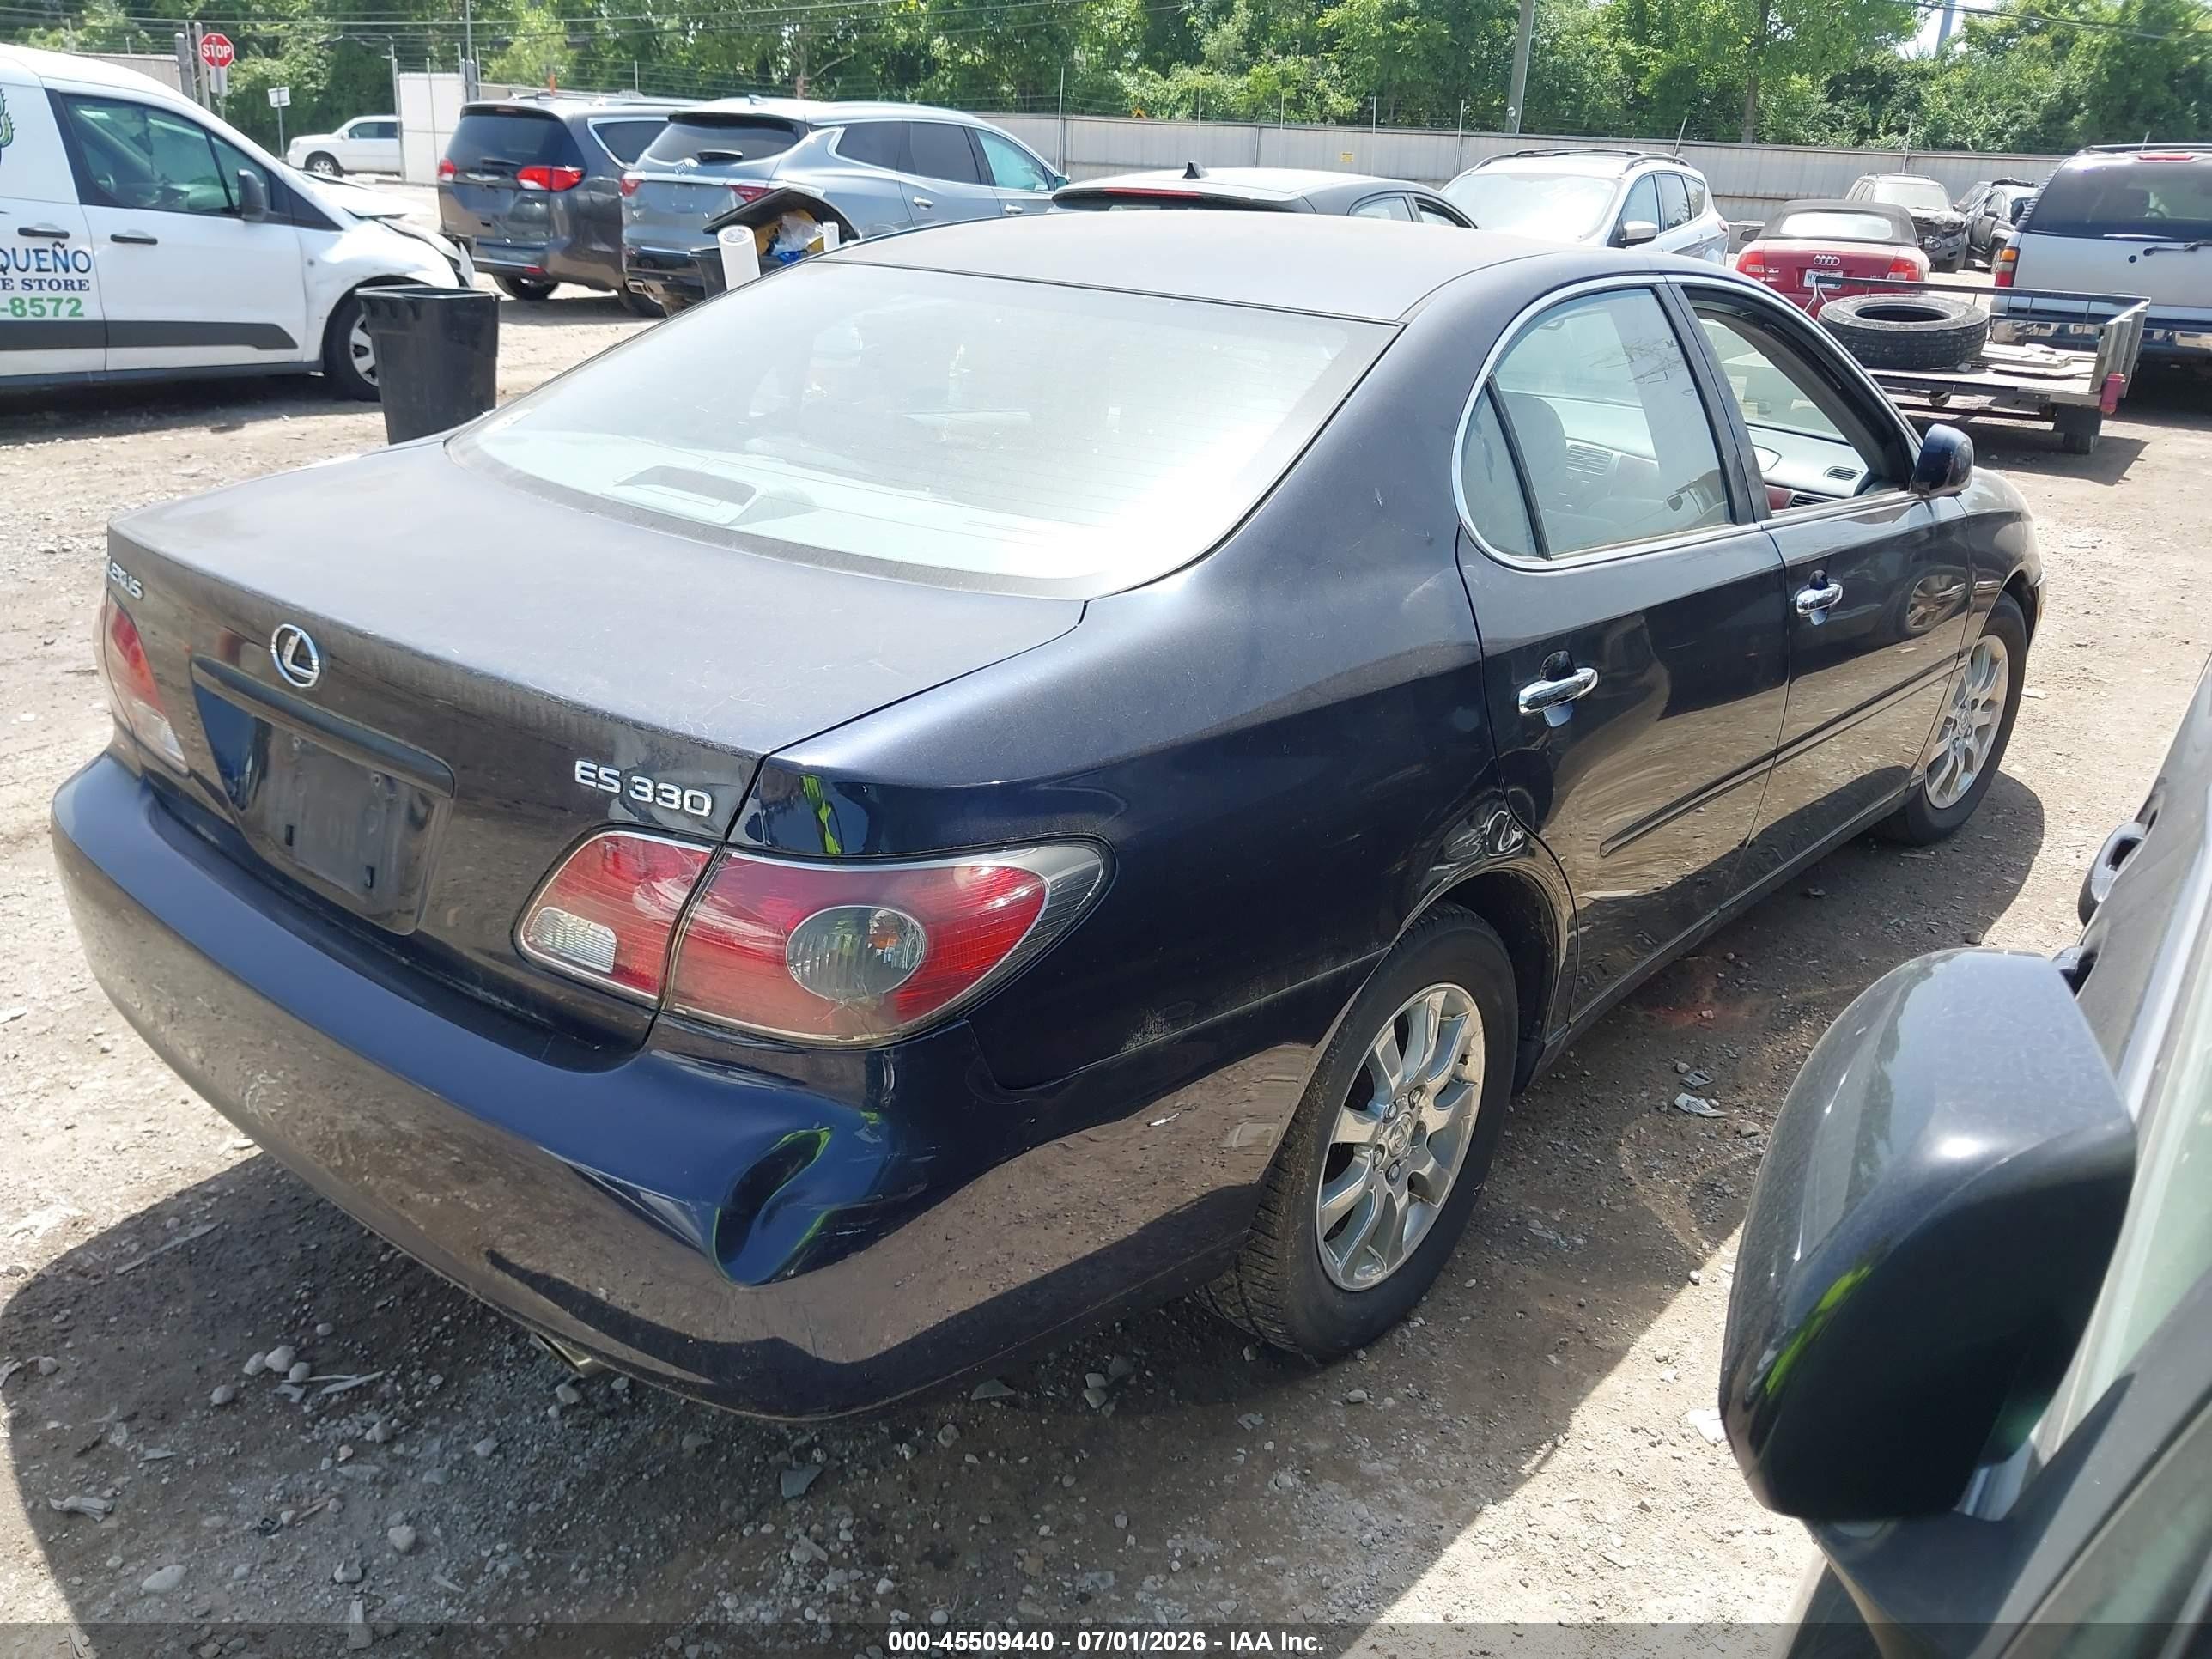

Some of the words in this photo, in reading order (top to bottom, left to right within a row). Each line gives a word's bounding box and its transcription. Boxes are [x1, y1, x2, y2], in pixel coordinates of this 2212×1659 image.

[202, 44, 231, 59] STOP
[21, 278, 90, 292] STORE
[0, 296, 84, 319] -8572
[574, 760, 623, 794] ES
[628, 775, 713, 817] 330
